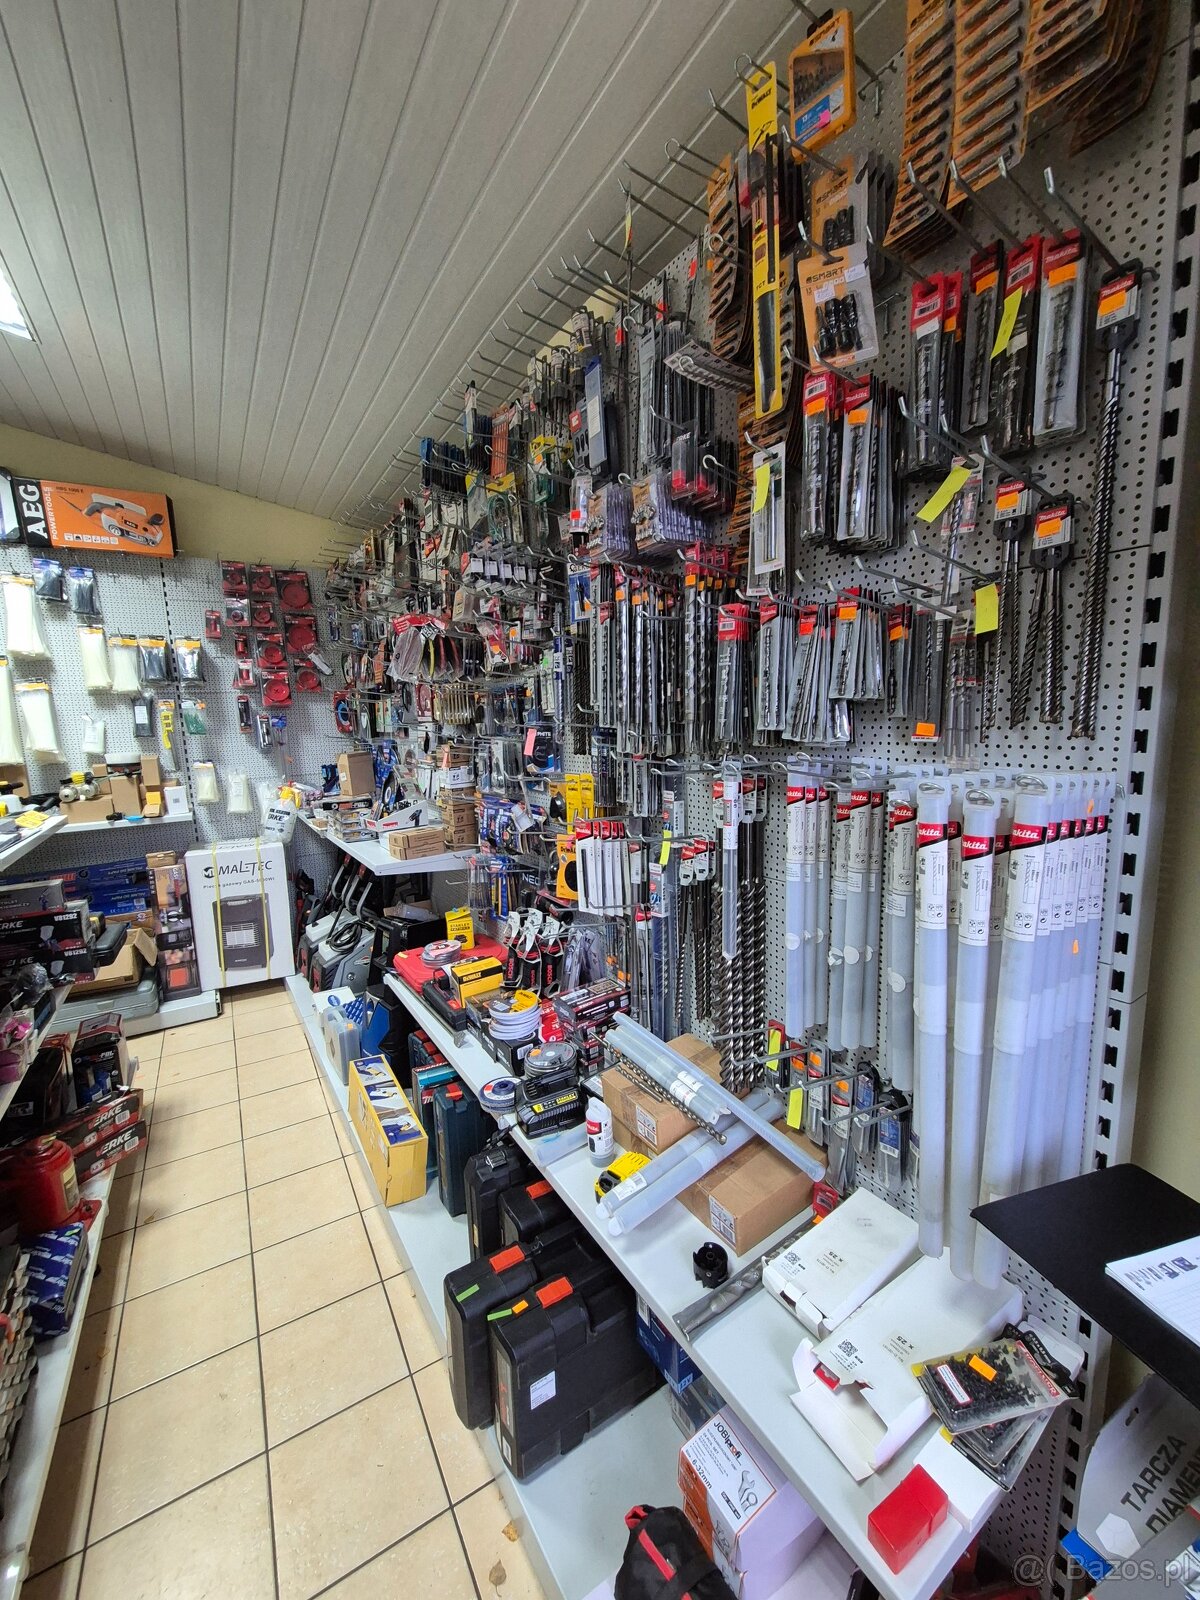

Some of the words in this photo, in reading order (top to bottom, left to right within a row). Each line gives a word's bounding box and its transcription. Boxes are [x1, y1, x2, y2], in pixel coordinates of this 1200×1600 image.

[812, 266, 845, 283] SMART
[19, 484, 49, 539] AEG
[43, 487, 58, 540] POWERTOOLS
[787, 790, 803, 798] kita
[851, 794, 869, 802] kita
[894, 808, 914, 817] kita
[918, 828, 943, 837] akita
[1012, 828, 1041, 840] akita
[560, 846, 577, 854] DeWAL
[962, 840, 989, 851] akita
[1121, 1434, 1188, 1512] TARCZA
